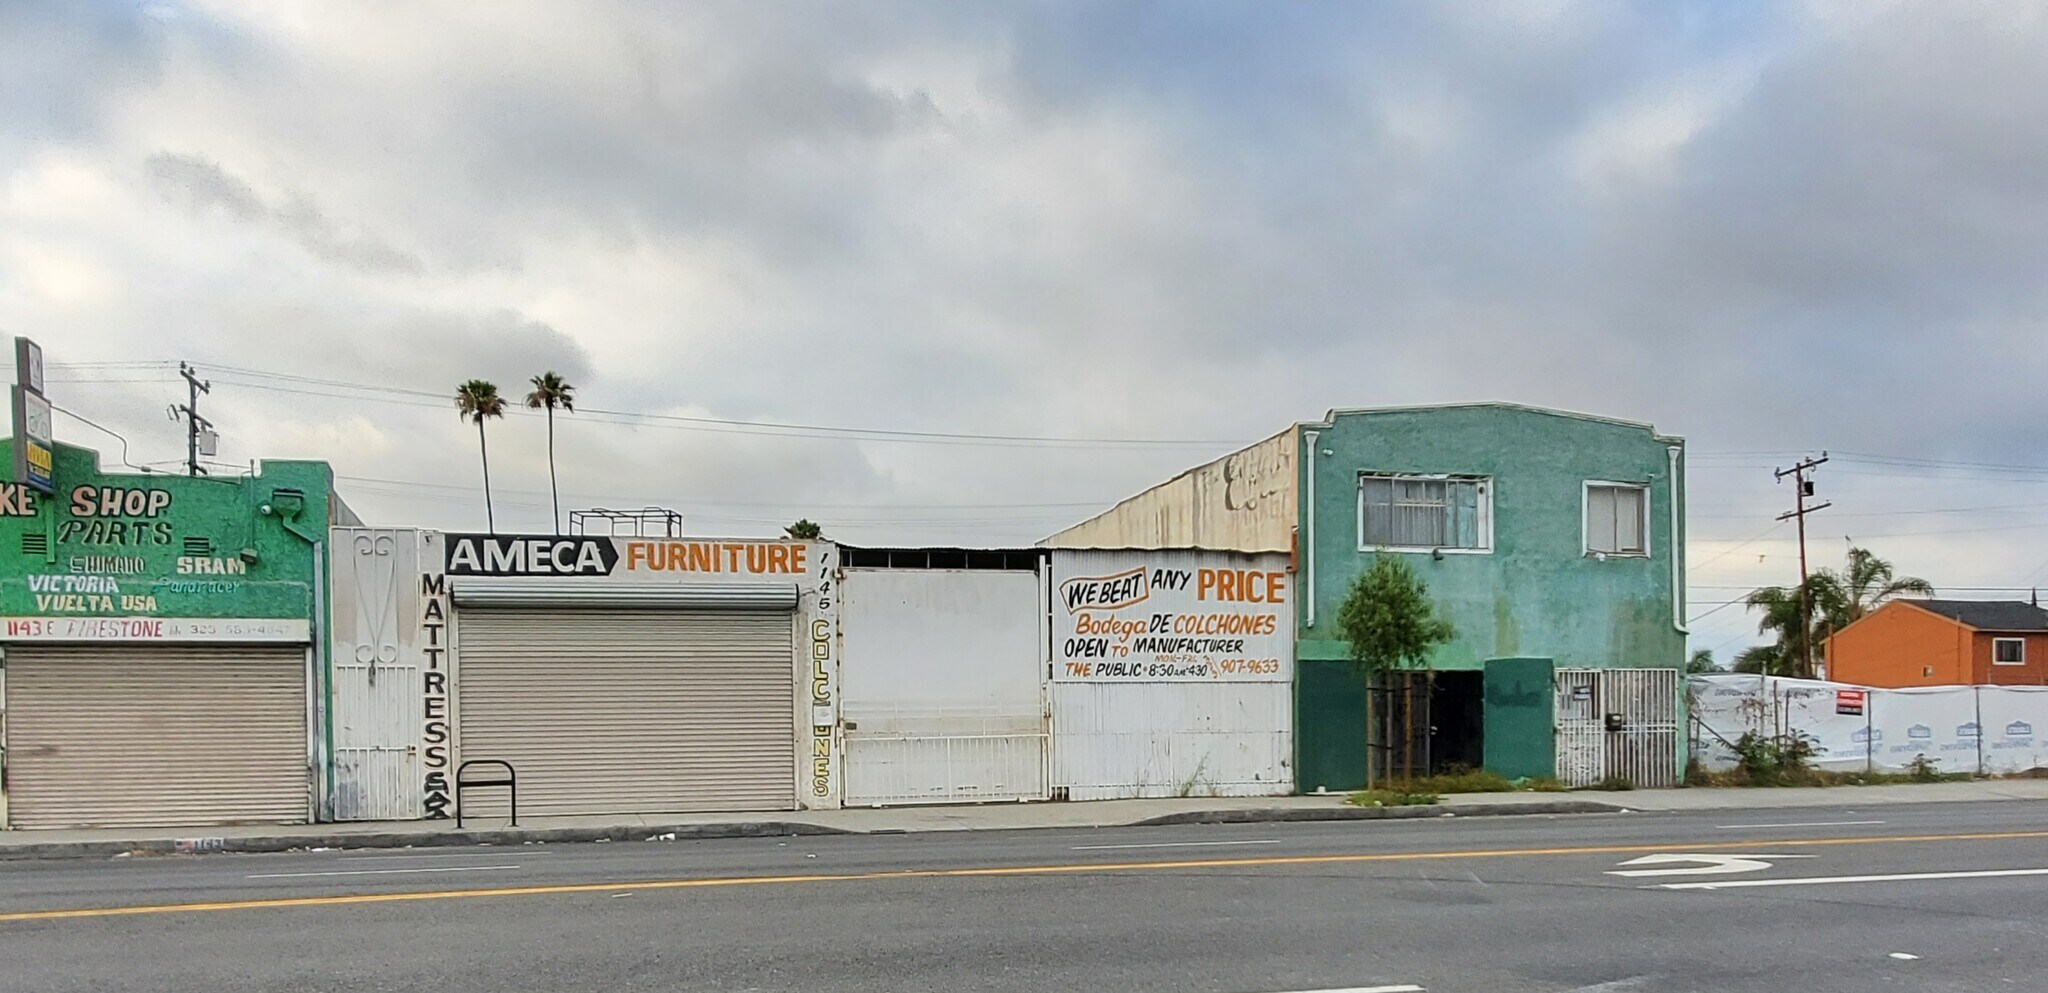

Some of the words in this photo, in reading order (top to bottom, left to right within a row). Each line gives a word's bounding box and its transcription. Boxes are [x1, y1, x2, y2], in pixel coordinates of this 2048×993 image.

[71, 485, 172, 519] SHOP
[57, 520, 173, 546] PARTS
[177, 556, 246, 575] SRAM
[449, 539, 607, 573] AMECA
[627, 542, 806, 574] FURNITURE
[27, 574, 120, 593] VICTORIA
[818, 552, 830, 610] 1145
[1068, 582, 1096, 608] WE
[1098, 574, 1142, 604] BEAT
[1151, 569, 1191, 590] ANY
[1197, 568, 1285, 603] PRICE
[36, 595, 114, 612] VUELTA
[121, 595, 158, 611] USA
[8, 621, 42, 636] 1143
[1075, 613, 1147, 642] Bodega
[1149, 614, 1173, 634] DE
[1174, 613, 1276, 635] COLCHONES
[1064, 638, 1109, 657] OPEN
[1111, 645, 1128, 658] TO
[1133, 638, 1244, 654] MANUFACTURER
[1065, 662, 1091, 677] THE
[1096, 663, 1142, 677] PUBLIC
[1220, 659, 1279, 674] 907-9633
[812, 619, 831, 798] COLCONES
